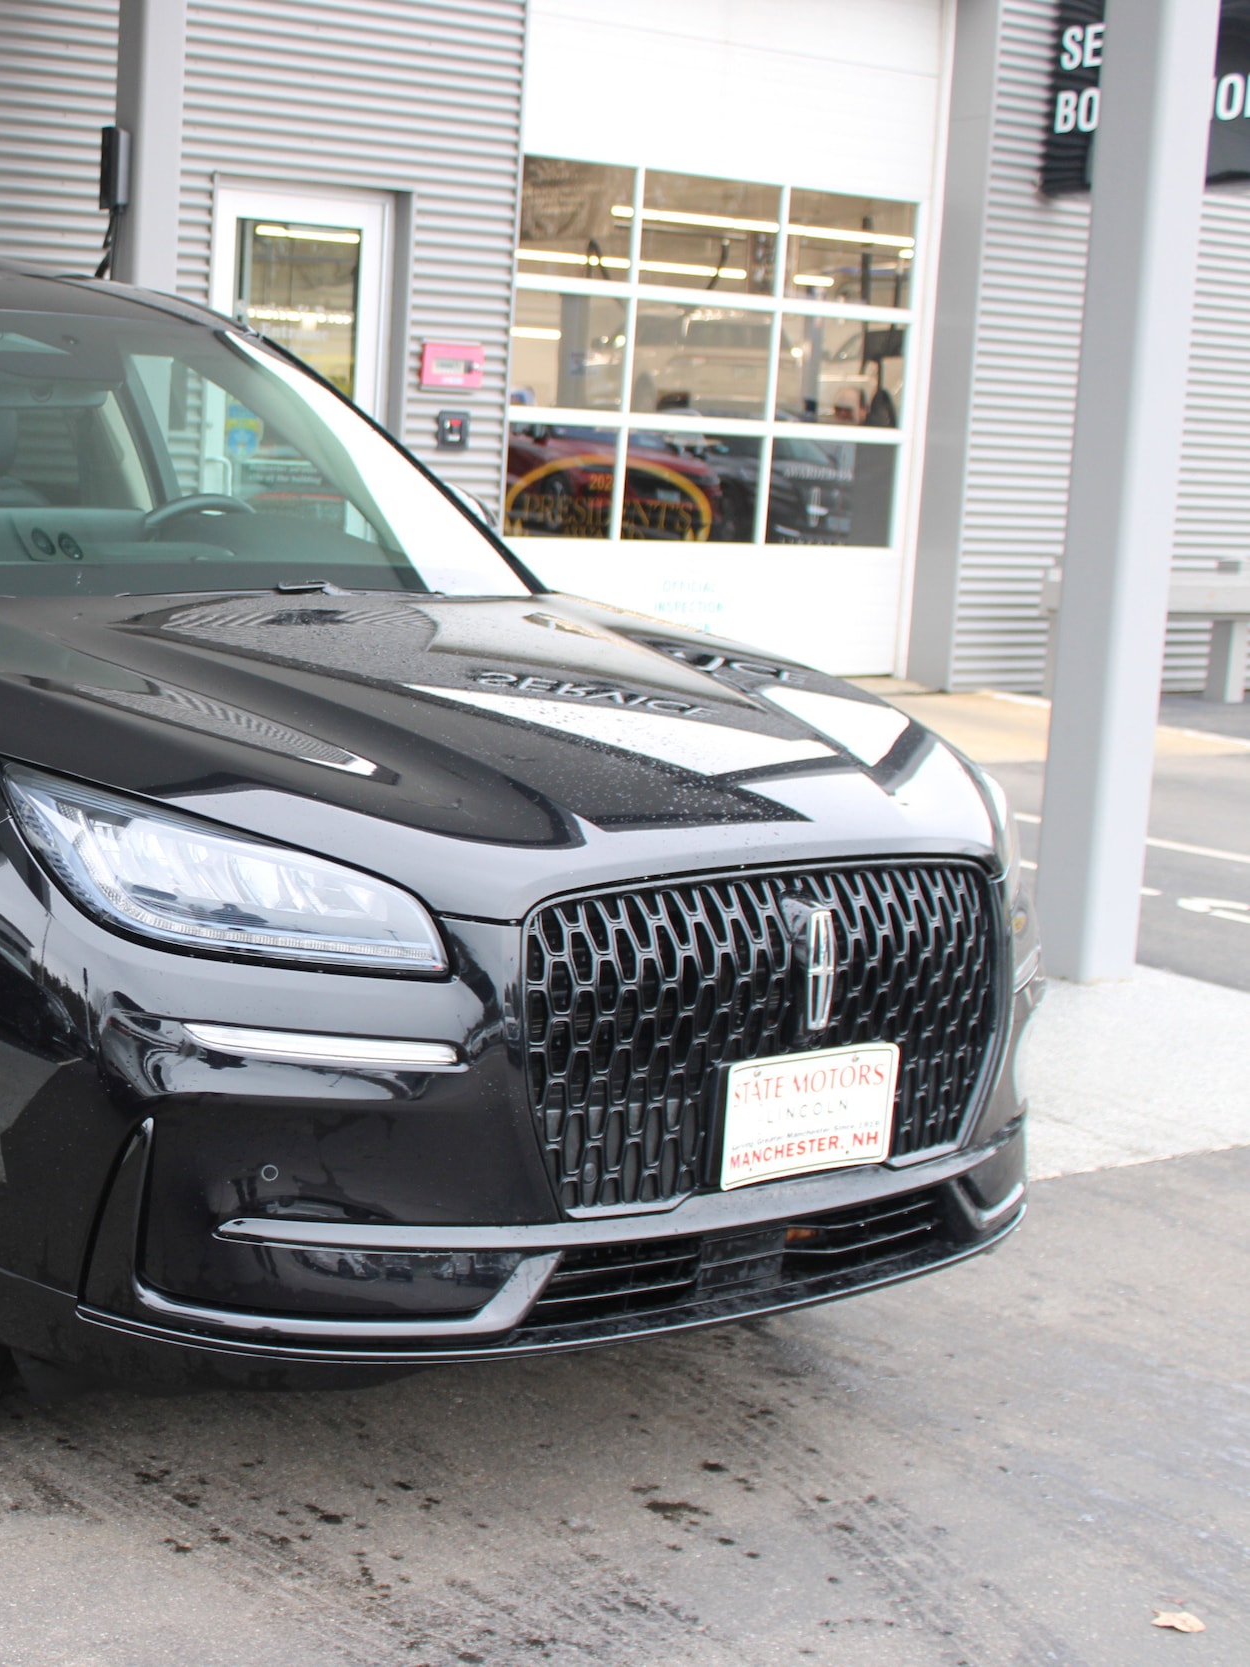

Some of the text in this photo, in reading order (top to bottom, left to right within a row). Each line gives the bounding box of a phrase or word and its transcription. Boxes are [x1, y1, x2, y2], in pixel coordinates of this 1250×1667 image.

[589, 473, 615, 491] 202
[733, 1063, 886, 1108] STATE MOTORS
[766, 1100, 849, 1124] LINCOLN
[851, 1131, 880, 1147] NH
